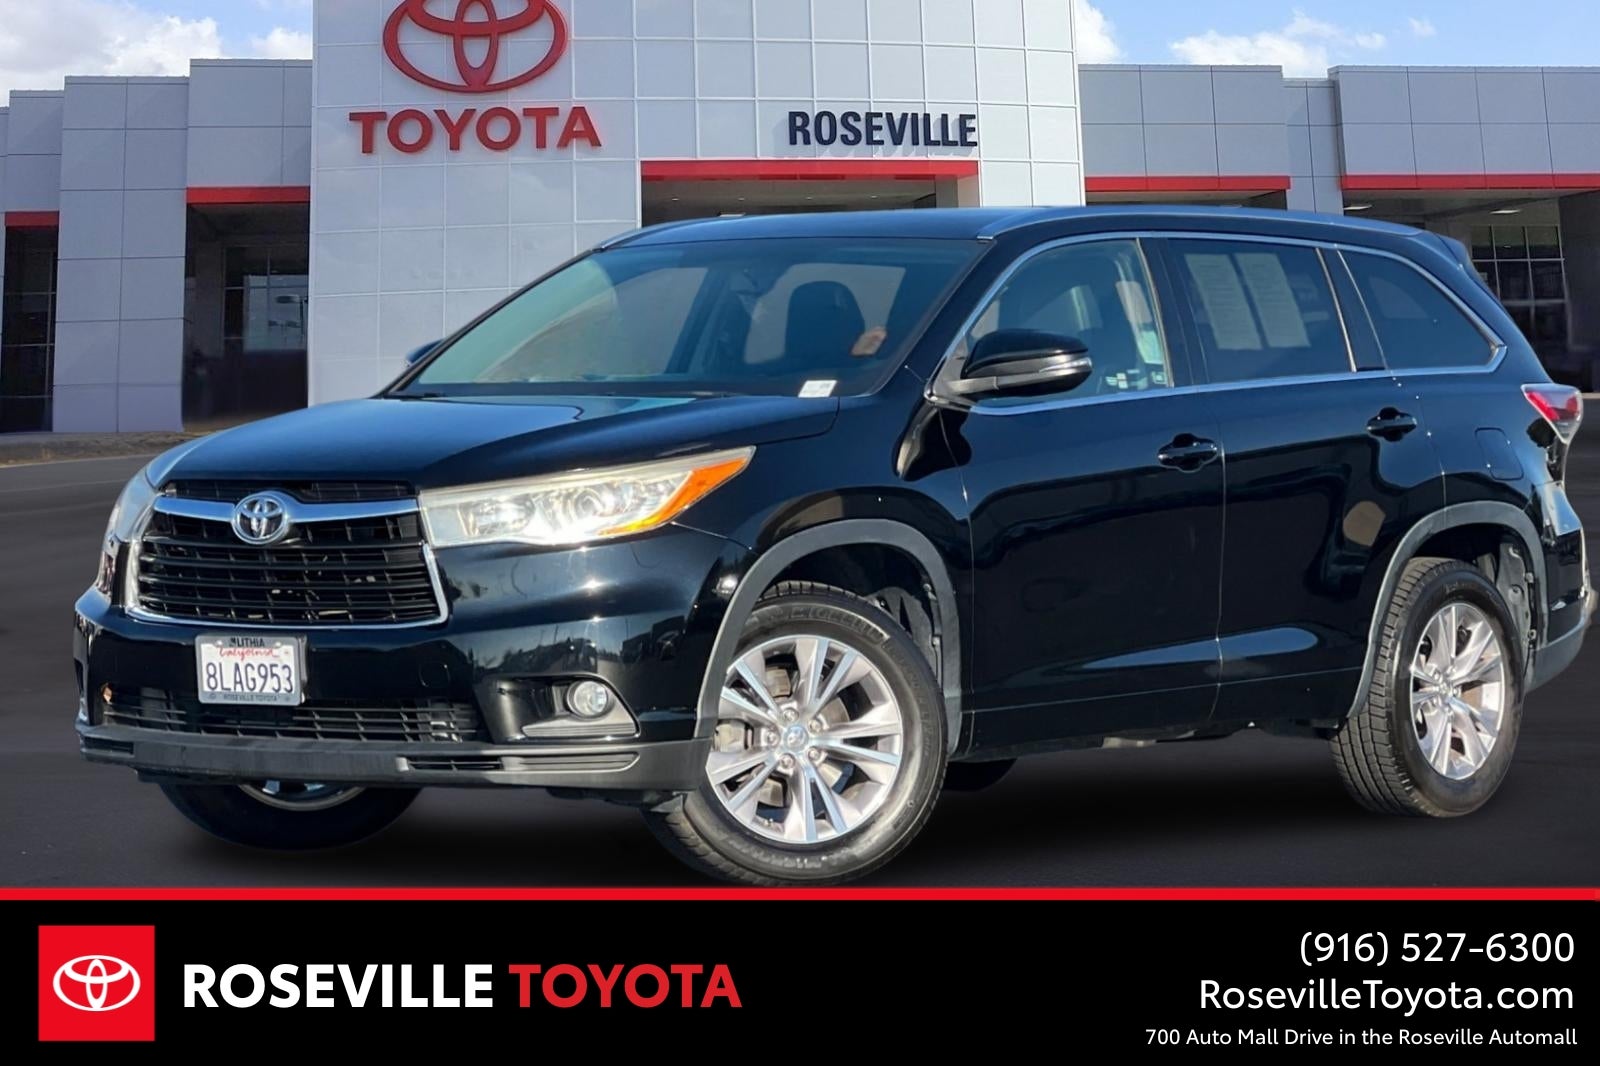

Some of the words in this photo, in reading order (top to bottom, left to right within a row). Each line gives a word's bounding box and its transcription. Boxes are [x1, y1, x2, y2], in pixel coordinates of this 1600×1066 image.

[349, 106, 602, 154] TOYOTA
[788, 110, 978, 147] ROSEVILLE
[237, 637, 265, 647] LITHIA
[218, 647, 280, 661] California
[206, 662, 293, 694] 8LAG953
[255, 694, 278, 702] TOYOTA
